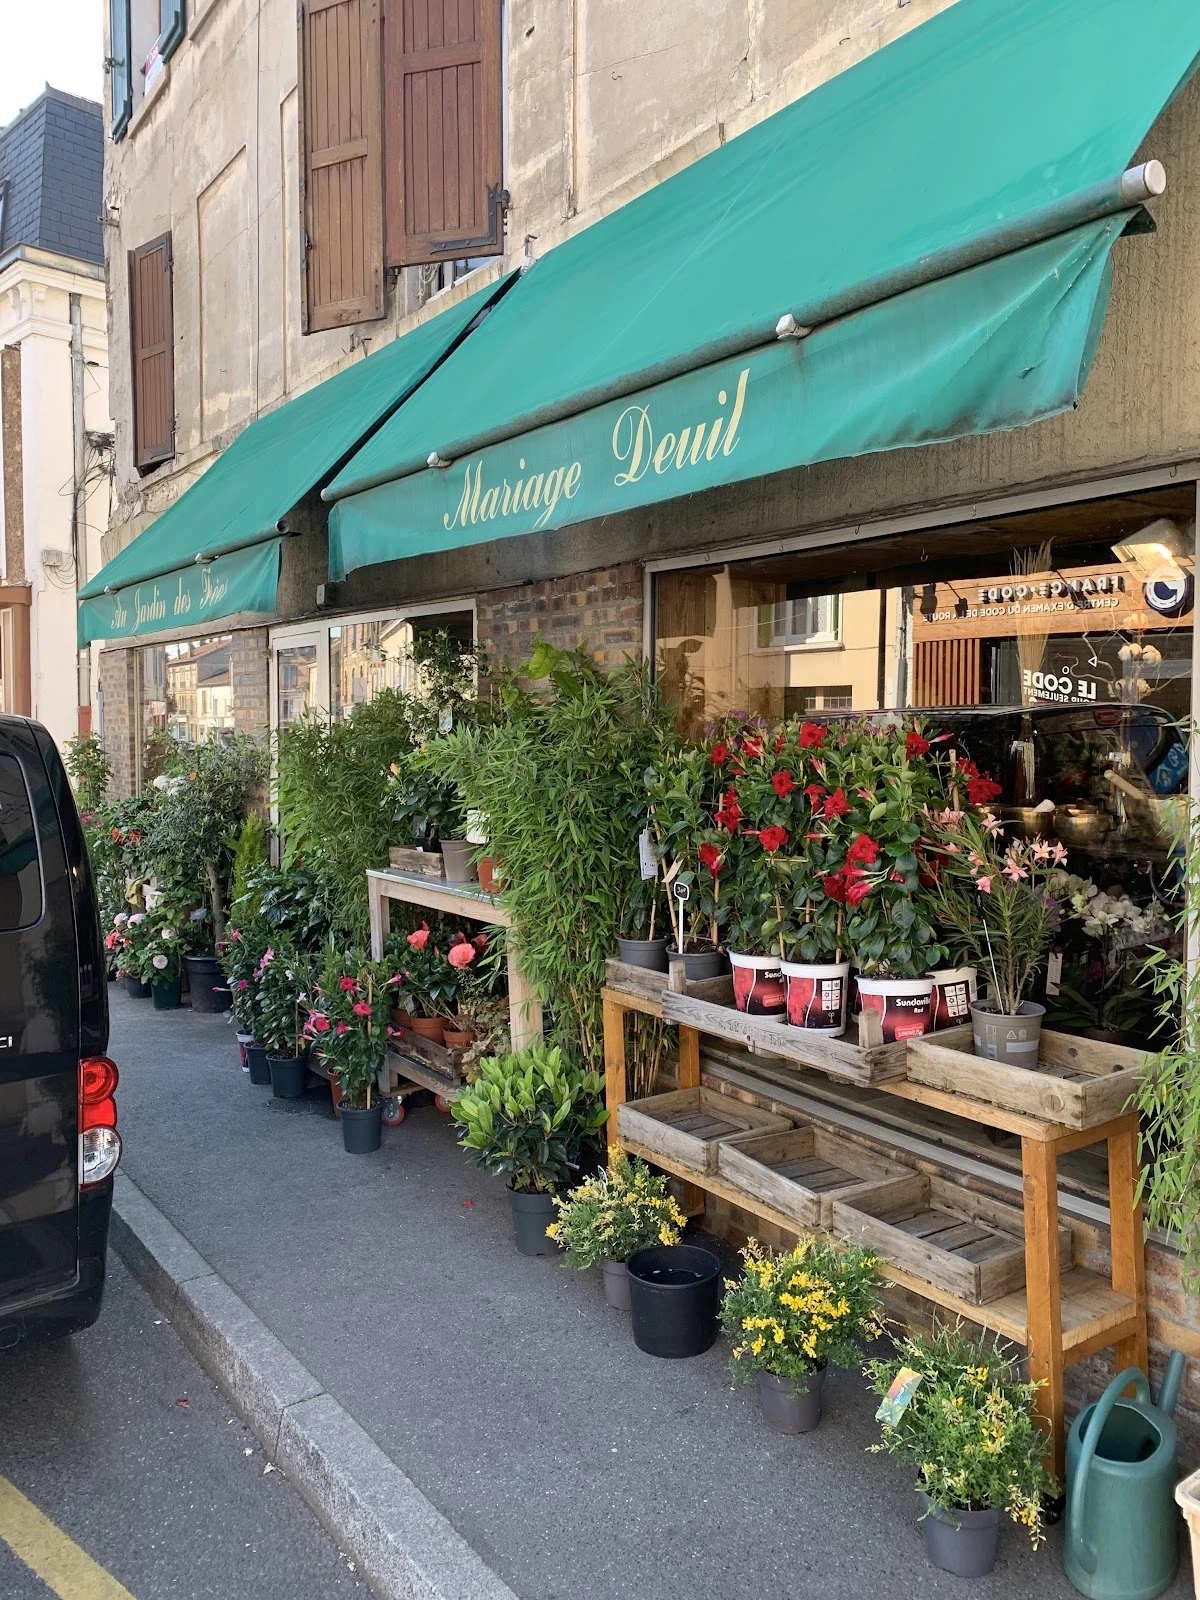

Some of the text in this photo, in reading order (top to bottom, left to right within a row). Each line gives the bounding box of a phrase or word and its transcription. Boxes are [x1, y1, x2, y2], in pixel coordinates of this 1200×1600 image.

[443, 368, 750, 531] Mariage Deuil
[111, 595, 127, 629] Au
[130, 585, 166, 634] Jardin
[173, 577, 191, 616] des
